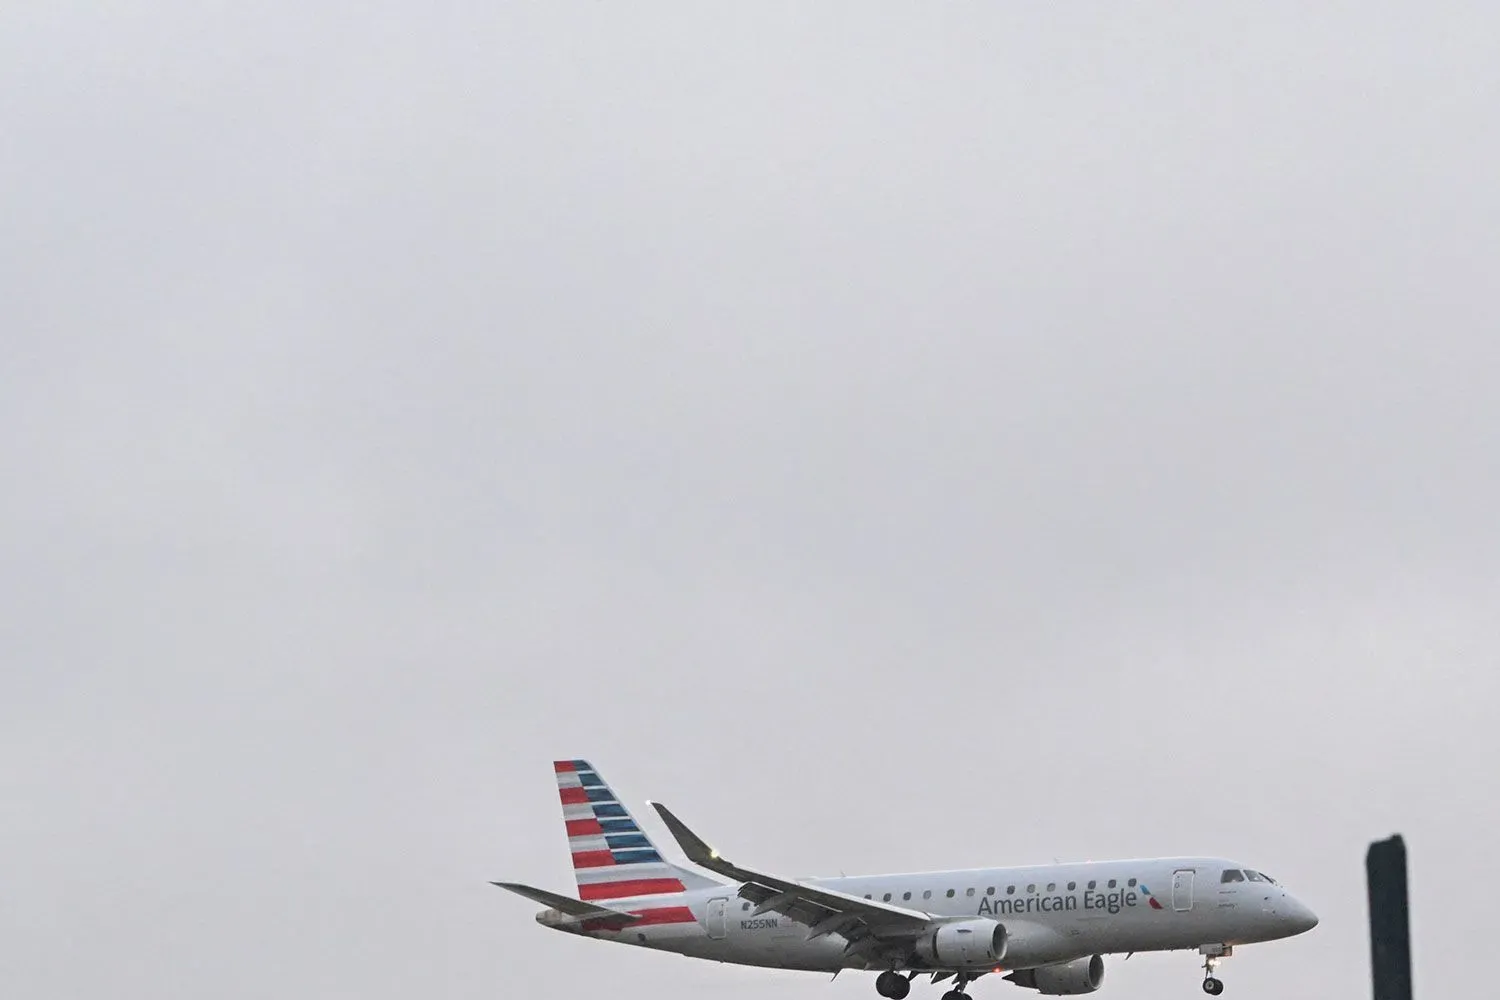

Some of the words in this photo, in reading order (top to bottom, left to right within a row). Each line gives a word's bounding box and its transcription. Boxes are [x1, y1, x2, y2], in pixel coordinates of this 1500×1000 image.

[978, 893, 1077, 916] American
[1084, 888, 1137, 914] Eagle
[740, 919, 778, 930] N255NN
